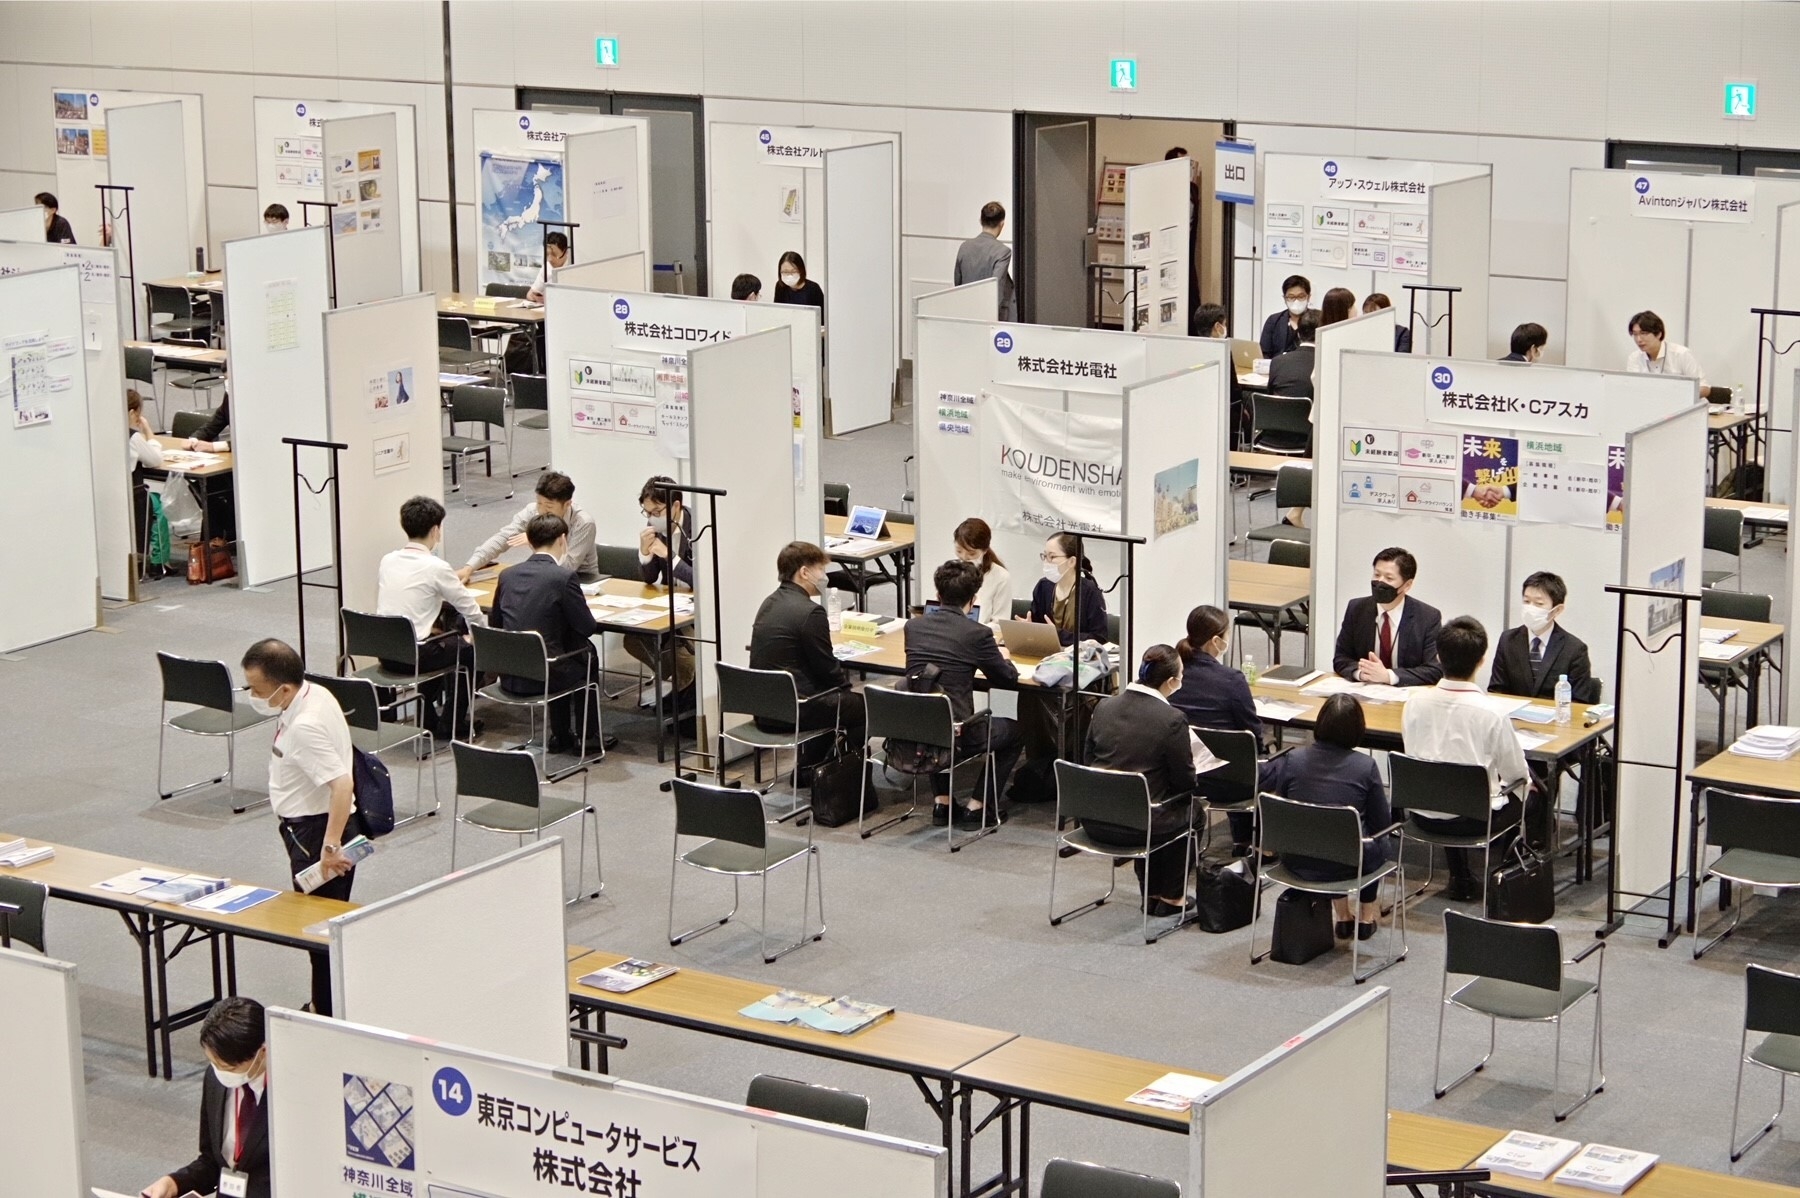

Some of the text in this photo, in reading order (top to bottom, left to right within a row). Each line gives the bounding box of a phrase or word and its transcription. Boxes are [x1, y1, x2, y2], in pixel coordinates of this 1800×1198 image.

[520, 119, 529, 127] 44
[1224, 163, 1245, 181] 出口
[1635, 181, 1648, 190] 47
[615, 303, 628, 315] 28
[624, 320, 731, 343] 株式会社コロワイド
[996, 337, 1011, 348] 29
[1017, 355, 1117, 379] 株式会社光電社
[1434, 372, 1451, 384] 30
[940, 393, 974, 405] 神奈川全域
[1441, 391, 1589, 419] 株式会社K・Cアスカ
[938, 408, 968, 419] 横浜地域
[939, 422, 969, 434] 県央地域
[1364, 448, 1399, 457] 未経験者歓迎
[1463, 436, 1502, 459] 未来
[1526, 440, 1563, 453] 横浜地域
[1499, 457, 1508, 466] を
[1001, 469, 1022, 480] make
[1079, 487, 1096, 496] with
[438, 1079, 464, 1104] 14
[477, 1092, 701, 1172] 東京コンピュータサービス
[532, 1146, 642, 1198] 株式会社
[343, 1165, 414, 1197] 神奈川全域
